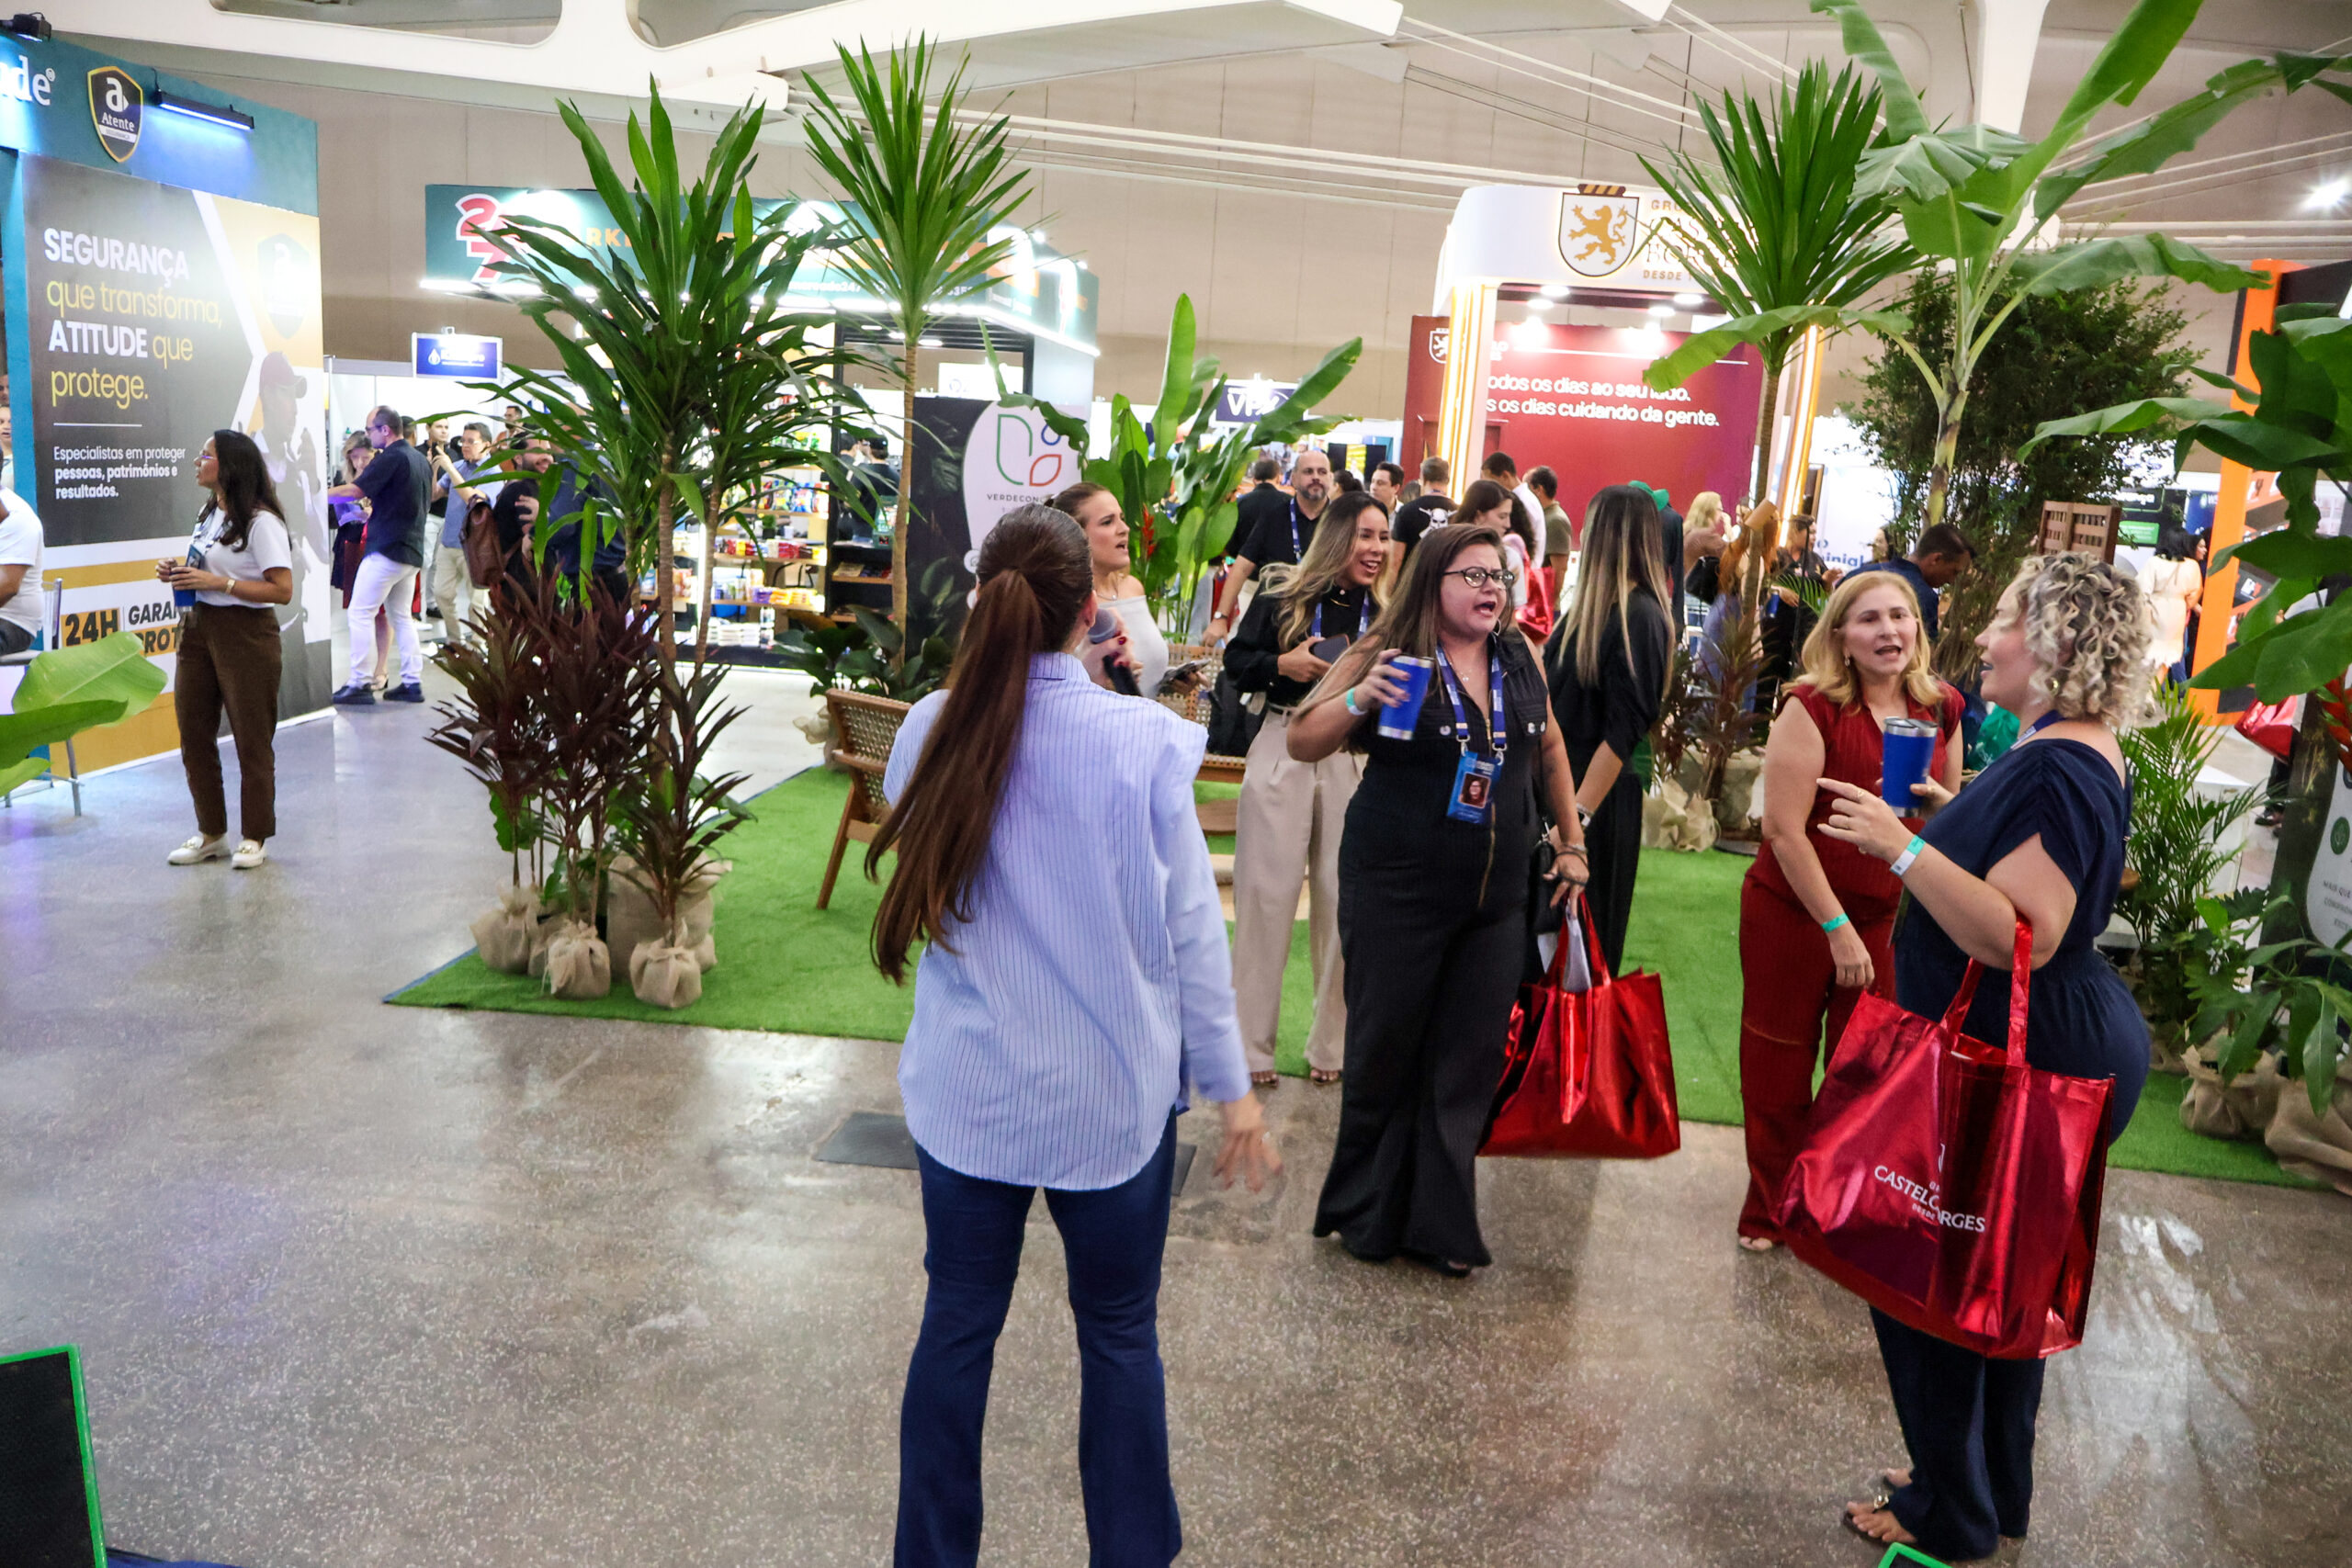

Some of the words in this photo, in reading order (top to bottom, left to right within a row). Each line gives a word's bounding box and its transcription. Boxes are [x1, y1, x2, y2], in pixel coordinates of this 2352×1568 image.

[101, 111, 136, 132] Atente
[44, 228, 190, 288] SEGURANÇA
[1643, 270, 1682, 281] DESDE
[47, 280, 96, 318] que
[100, 281, 222, 329] transforma,
[49, 319, 148, 358] ATITUDE
[153, 334, 194, 369] que
[51, 367, 149, 410] protege.
[1487, 374, 1529, 391] odos
[1531, 377, 1554, 392] os
[1553, 377, 1589, 395] dias
[1590, 381, 1613, 398] ao
[1615, 382, 1646, 399] seu
[1498, 399, 1521, 412] os
[1521, 398, 1556, 415] dias
[1558, 400, 1638, 422] cuidando
[1640, 404, 1663, 423] da
[1665, 408, 1720, 428] gente.
[53, 446, 124, 465] Especialistas
[125, 449, 143, 459] em
[144, 446, 187, 463] proteger
[54, 467, 106, 484] pessoas,
[107, 462, 170, 483] patrimônios
[171, 466, 178, 477] e
[55, 483, 119, 499] resultados.
[65, 609, 119, 646] 24H
